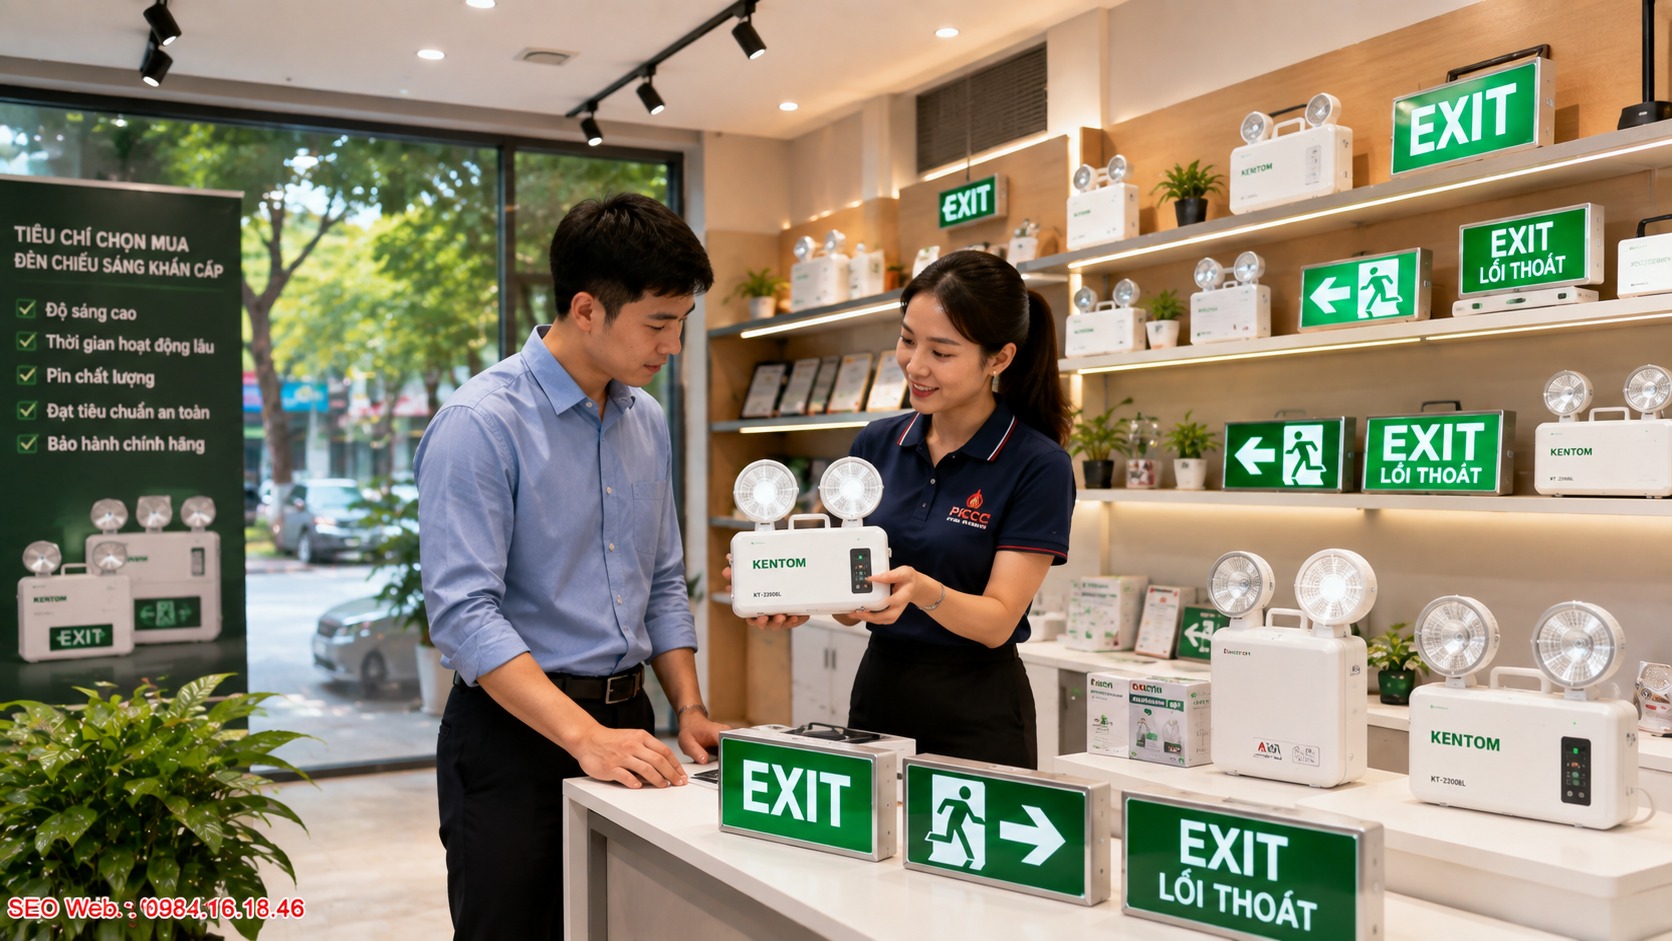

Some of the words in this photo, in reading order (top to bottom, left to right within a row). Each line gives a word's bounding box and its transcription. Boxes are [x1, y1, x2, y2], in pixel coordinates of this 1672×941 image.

[1410, 82, 1517, 157] EXIT
[943, 184, 991, 222] EXIT
[14, 223, 55, 244] TIÊU
[60, 227, 91, 246] CHÍ
[96, 231, 146, 252] CHỌN
[151, 235, 189, 252] MUA
[1491, 221, 1554, 258] EXIT
[14, 250, 47, 269] ĐÈN
[52, 252, 98, 272] CHIẾU
[103, 255, 145, 274] SÁNG
[194, 260, 223, 278] CẤP
[1510, 252, 1566, 280] THOÁT
[45, 302, 67, 321] Độ
[72, 303, 107, 322] sáng
[111, 309, 136, 320] cao
[46, 334, 79, 349] Thời
[83, 336, 115, 353] gian
[119, 336, 151, 355] hoạt
[154, 338, 190, 356] động
[47, 368, 71, 383] Pin
[75, 367, 109, 384] chất
[113, 369, 154, 388] lượng
[47, 403, 74, 421] Đạt
[78, 403, 106, 418] tiêu
[158, 408, 175, 419] an
[123, 436, 164, 451] chính
[169, 436, 205, 454] hãng
[1383, 423, 1484, 461] EXIT
[1551, 448, 1592, 456] KENTOM
[753, 558, 805, 569] KENTOM
[60, 628, 102, 646] EXIT
[1431, 731, 1499, 751] KENTOM
[743, 759, 851, 828] EXIT
[1180, 819, 1288, 882] EXIT
[1213, 890, 1318, 932] THOÁT
